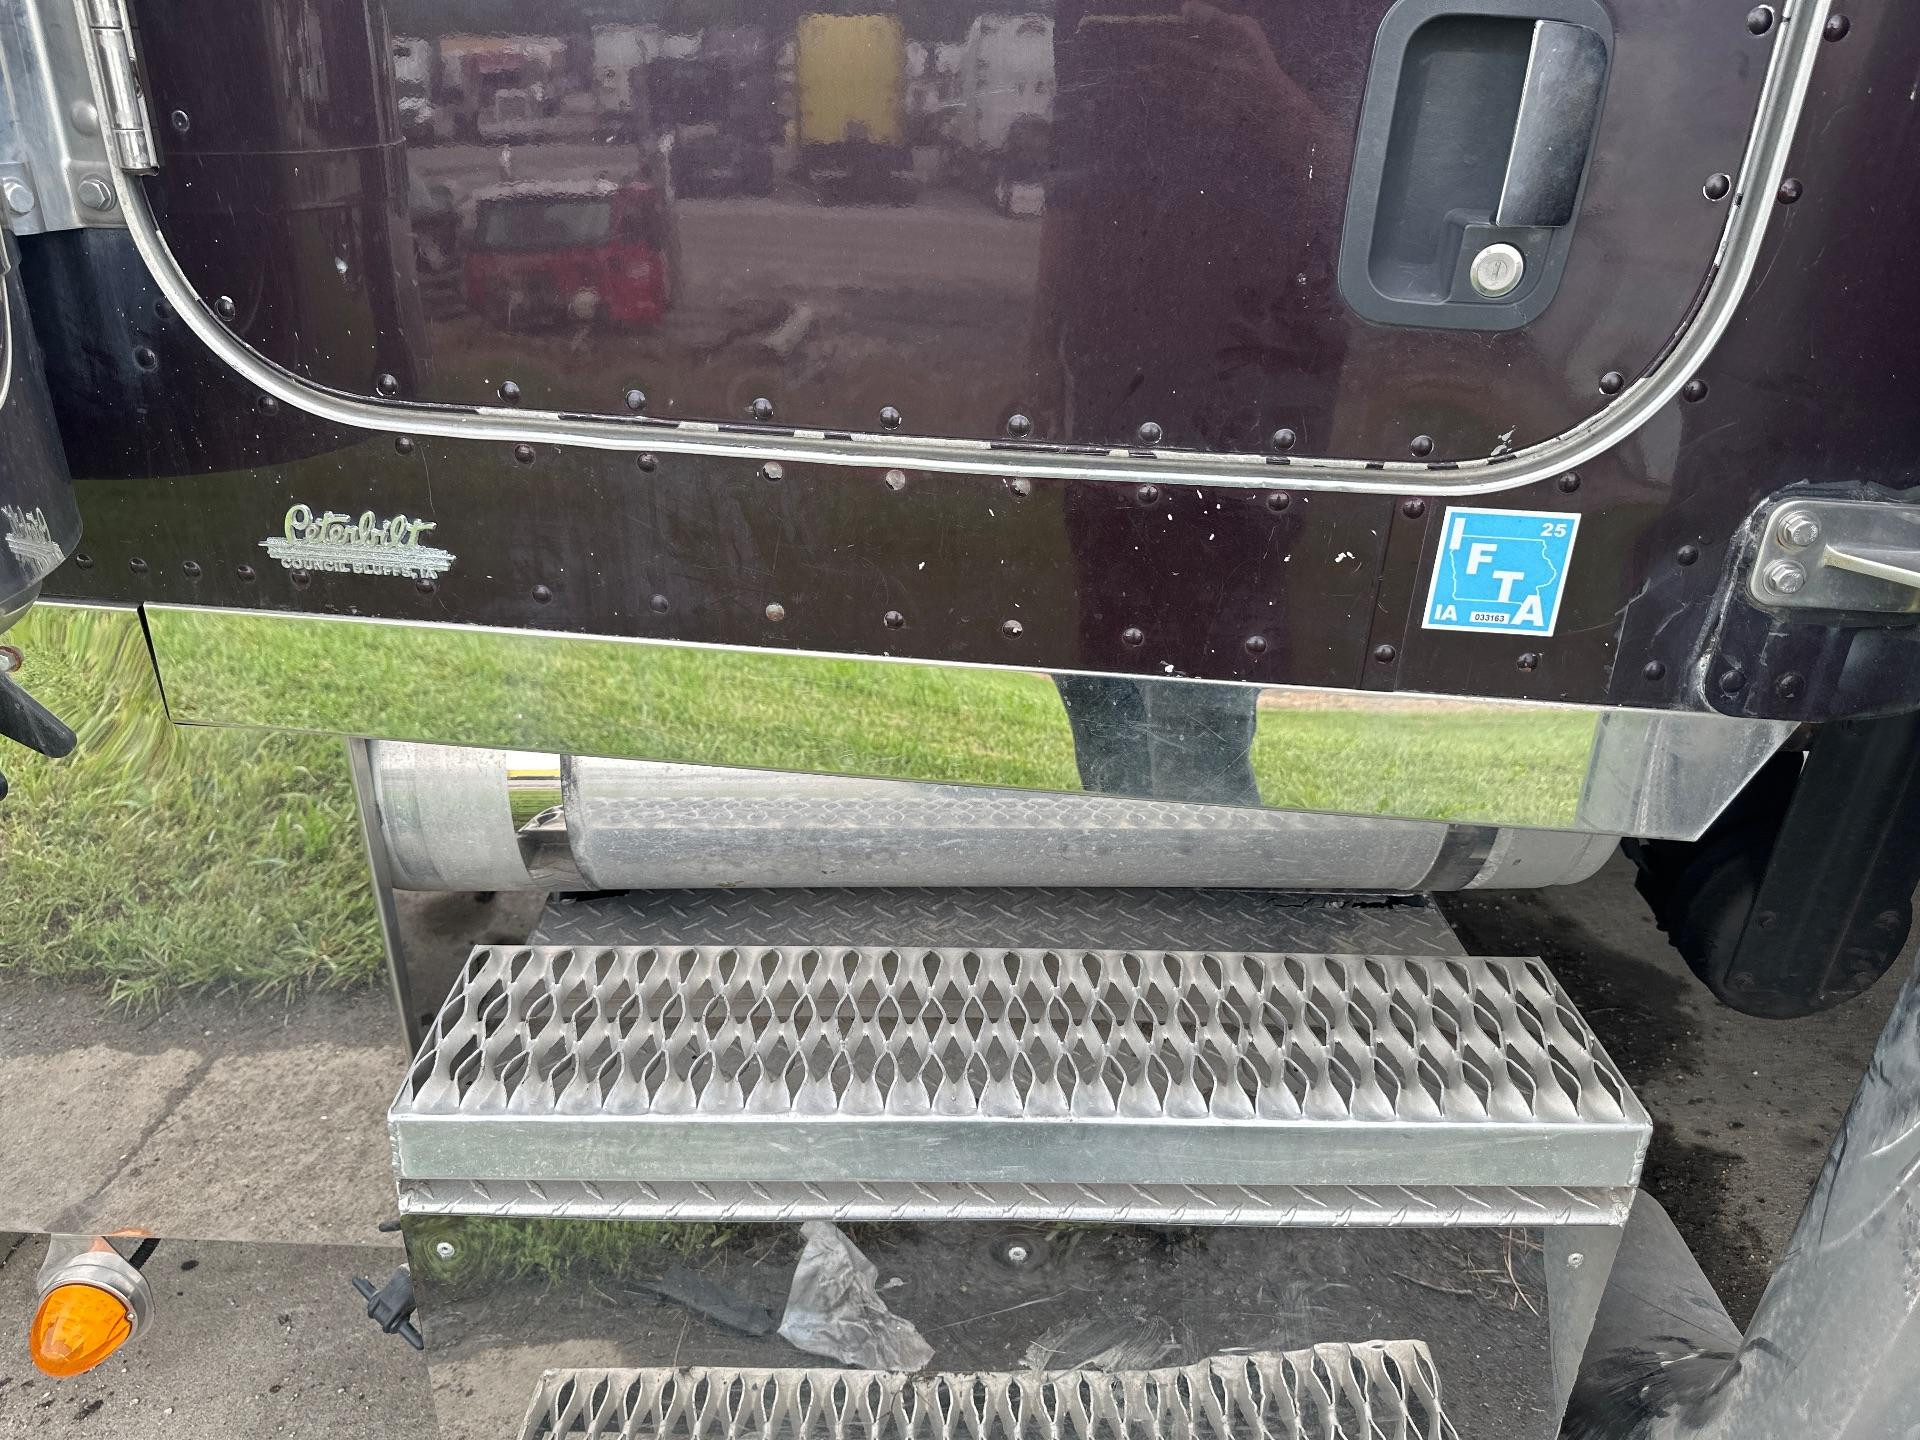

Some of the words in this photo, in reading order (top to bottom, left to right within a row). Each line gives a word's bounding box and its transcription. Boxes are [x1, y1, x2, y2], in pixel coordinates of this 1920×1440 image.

[284, 503, 437, 548] Peterbilt
[1540, 523, 1567, 538] 25
[1434, 604, 1457, 621] IA
[1474, 613, 1505, 622] 033163
